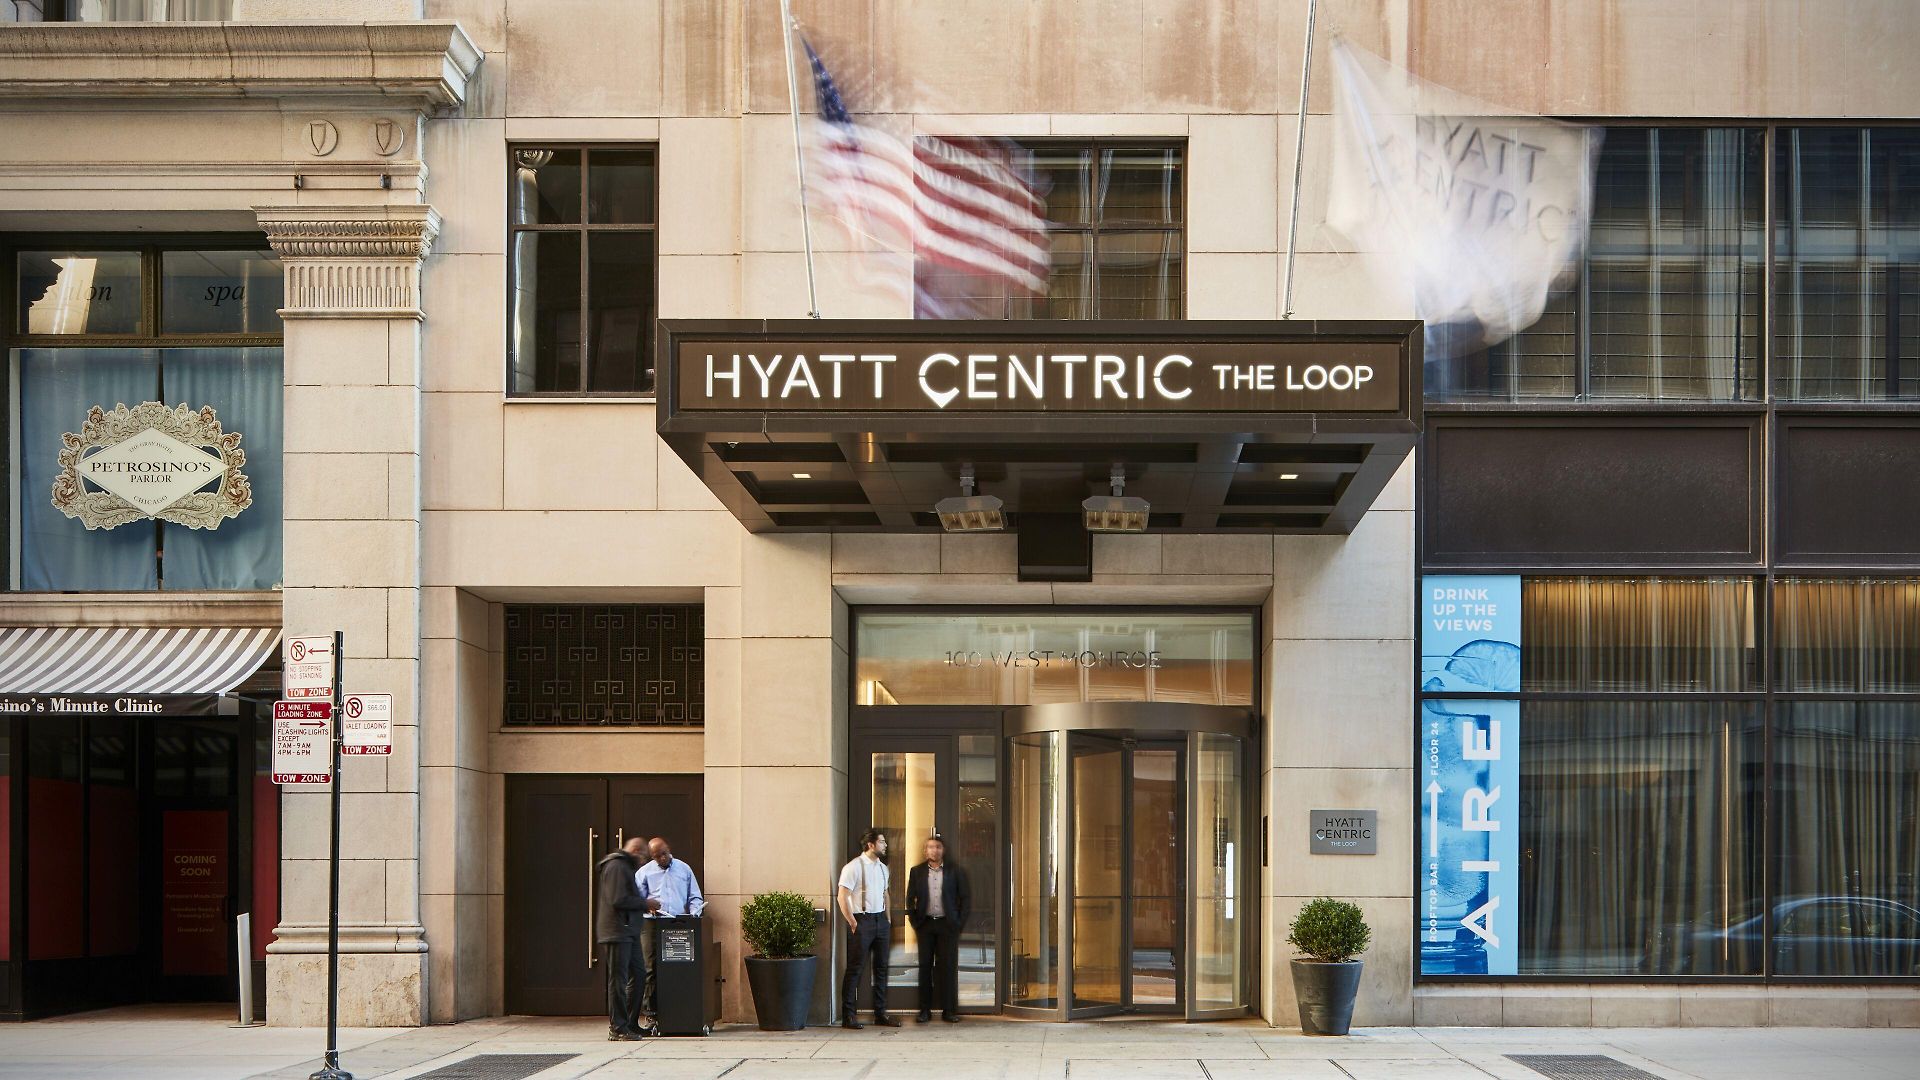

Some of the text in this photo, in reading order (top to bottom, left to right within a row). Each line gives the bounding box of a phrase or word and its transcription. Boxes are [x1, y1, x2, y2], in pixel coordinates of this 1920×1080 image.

[204, 284, 245, 307] spa
[706, 353, 1374, 409] HYATT CENTRIC THE LOOP
[91, 461, 211, 473] PETROSINO'S
[130, 474, 172, 483] PARLOR
[133, 495, 168, 505] CHICAGO
[1433, 588, 1489, 600] DRINK
[1433, 604, 1497, 615] UP THE
[1433, 619, 1493, 631] VIEWS
[944, 650, 1162, 668] 100 WEST MONROE
[289, 687, 329, 697] TOW ZONE
[50, 697, 109, 713] Minute
[114, 697, 163, 713] Clinic
[278, 703, 311, 711] 15 MINUTE
[363, 722, 387, 730] LOADING
[344, 745, 388, 754] TOW ZONE
[1430, 721, 1439, 776] FLOOR 24
[277, 774, 327, 783] TOW ZONE
[1325, 817, 1365, 828] HYATT
[1316, 828, 1371, 841] CENTRIC
[1460, 720, 1501, 949] AIRE
[174, 855, 217, 864] COMING
[180, 867, 211, 876] SOON
[1429, 862, 1438, 942] ROOFTOP BAR
